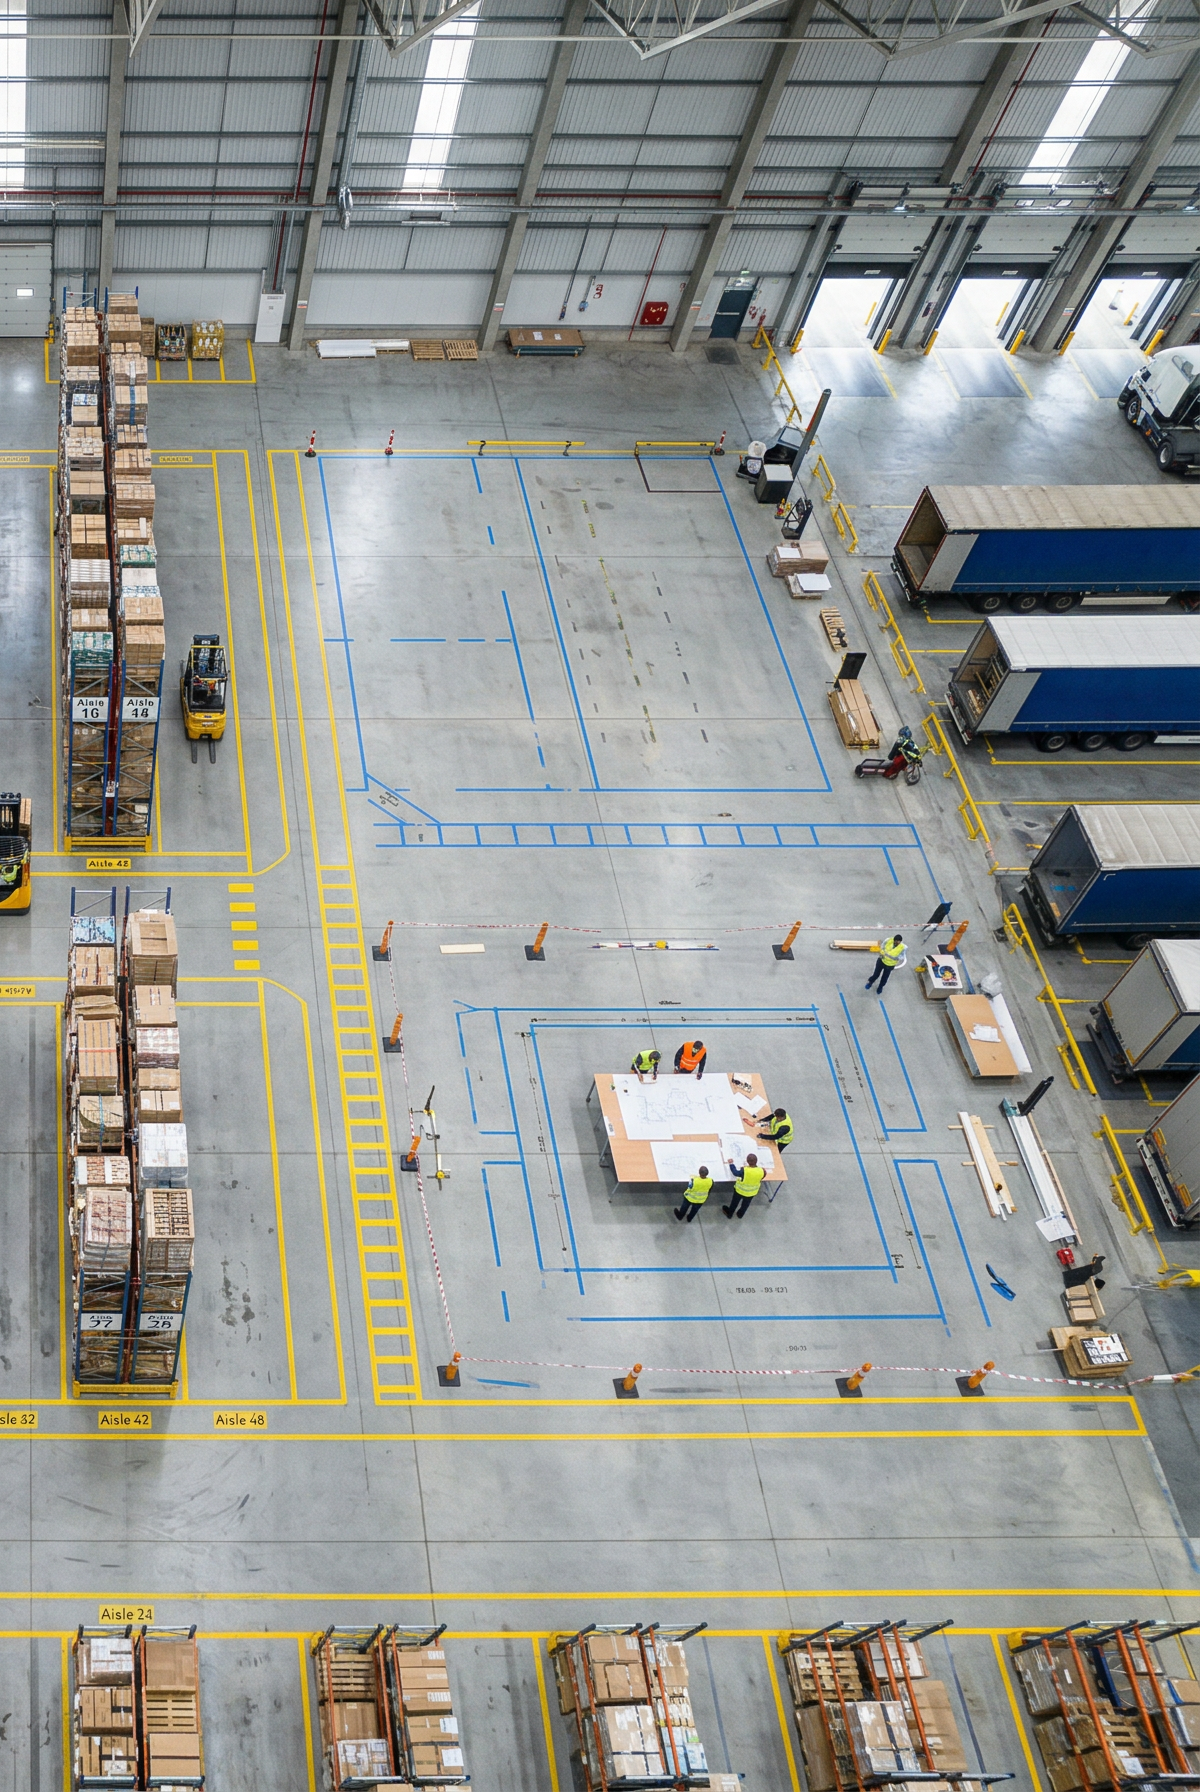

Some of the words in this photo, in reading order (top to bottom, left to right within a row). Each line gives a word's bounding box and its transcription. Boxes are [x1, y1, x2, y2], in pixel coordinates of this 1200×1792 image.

[100, 1413, 131, 1425] Aisle
[134, 1413, 149, 1425] 42
[216, 1413, 247, 1425] Aisle
[250, 1412, 265, 1425] 48
[102, 1607, 133, 1620] Aisle
